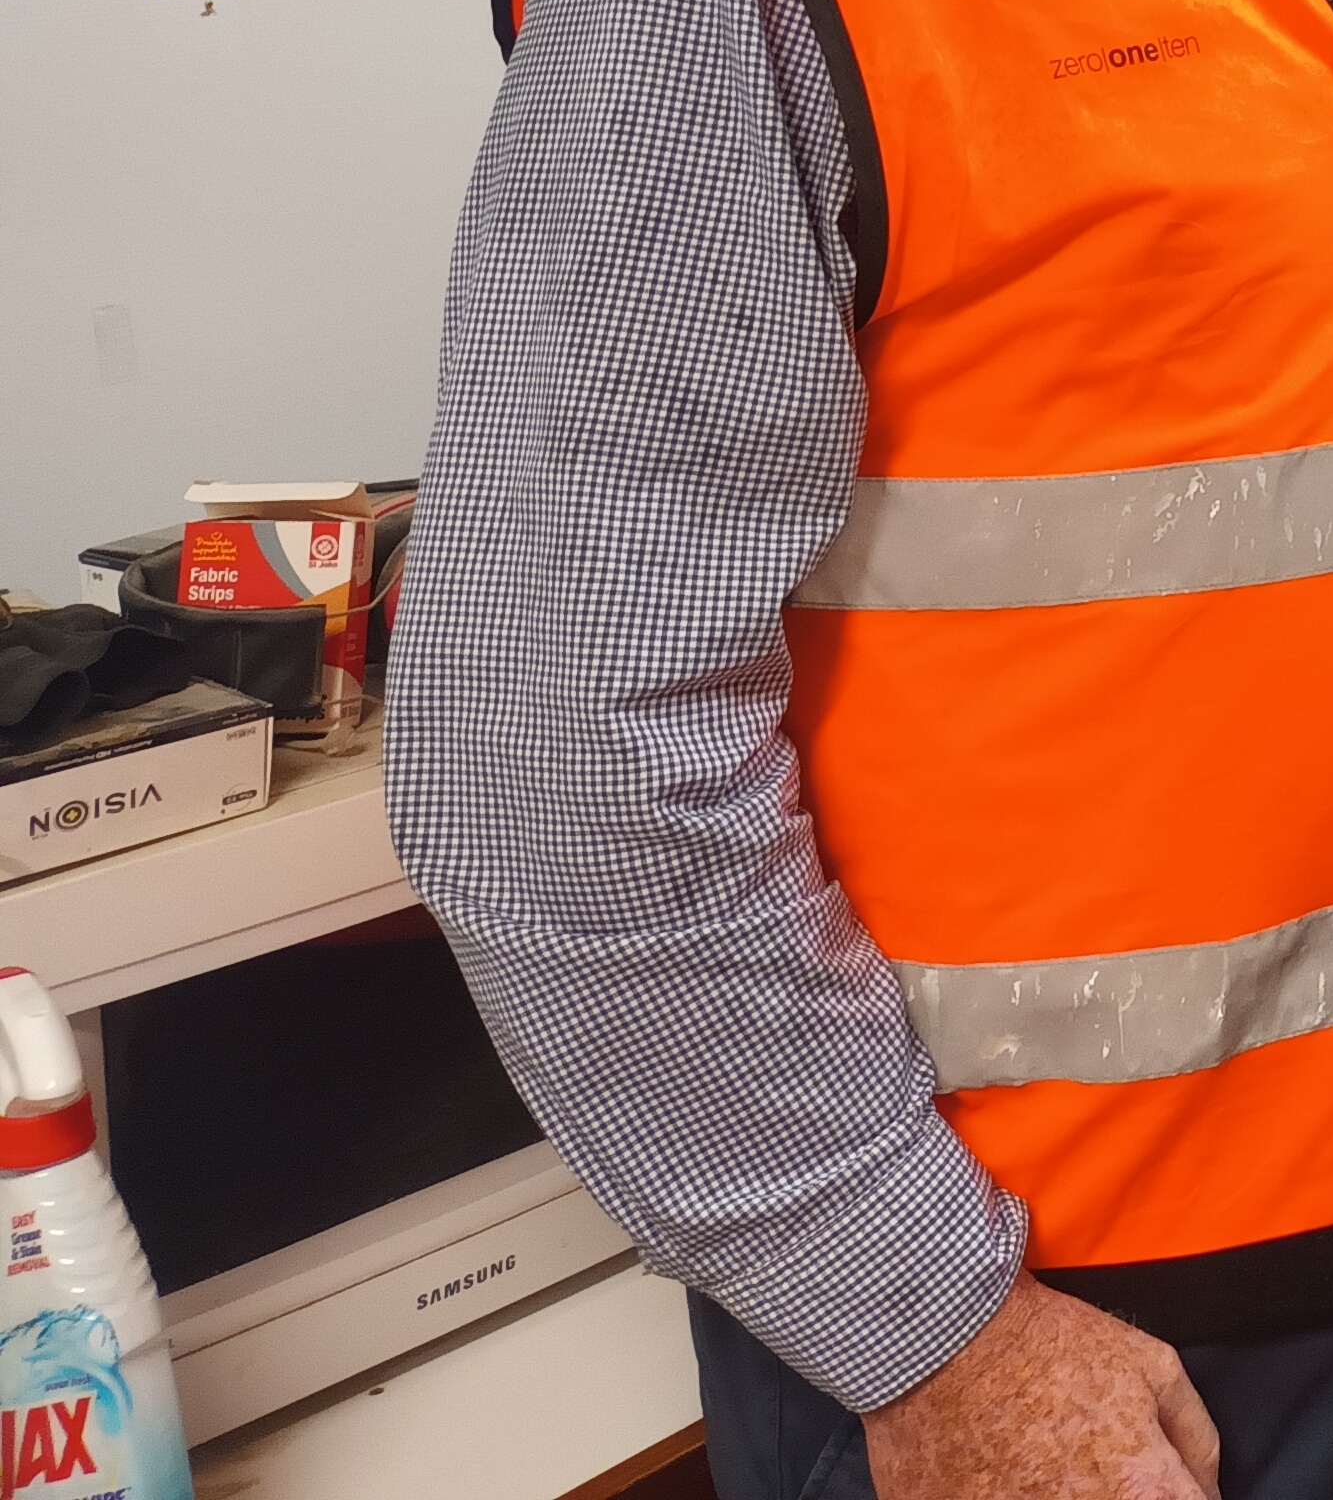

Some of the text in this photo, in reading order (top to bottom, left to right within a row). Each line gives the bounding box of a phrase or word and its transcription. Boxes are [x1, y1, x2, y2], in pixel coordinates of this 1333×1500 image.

[190, 567, 238, 583] Fabric
[188, 585, 234, 603] Strips
[28, 783, 162, 837] VISION
[416, 1254, 517, 1310] SAMSUNG
